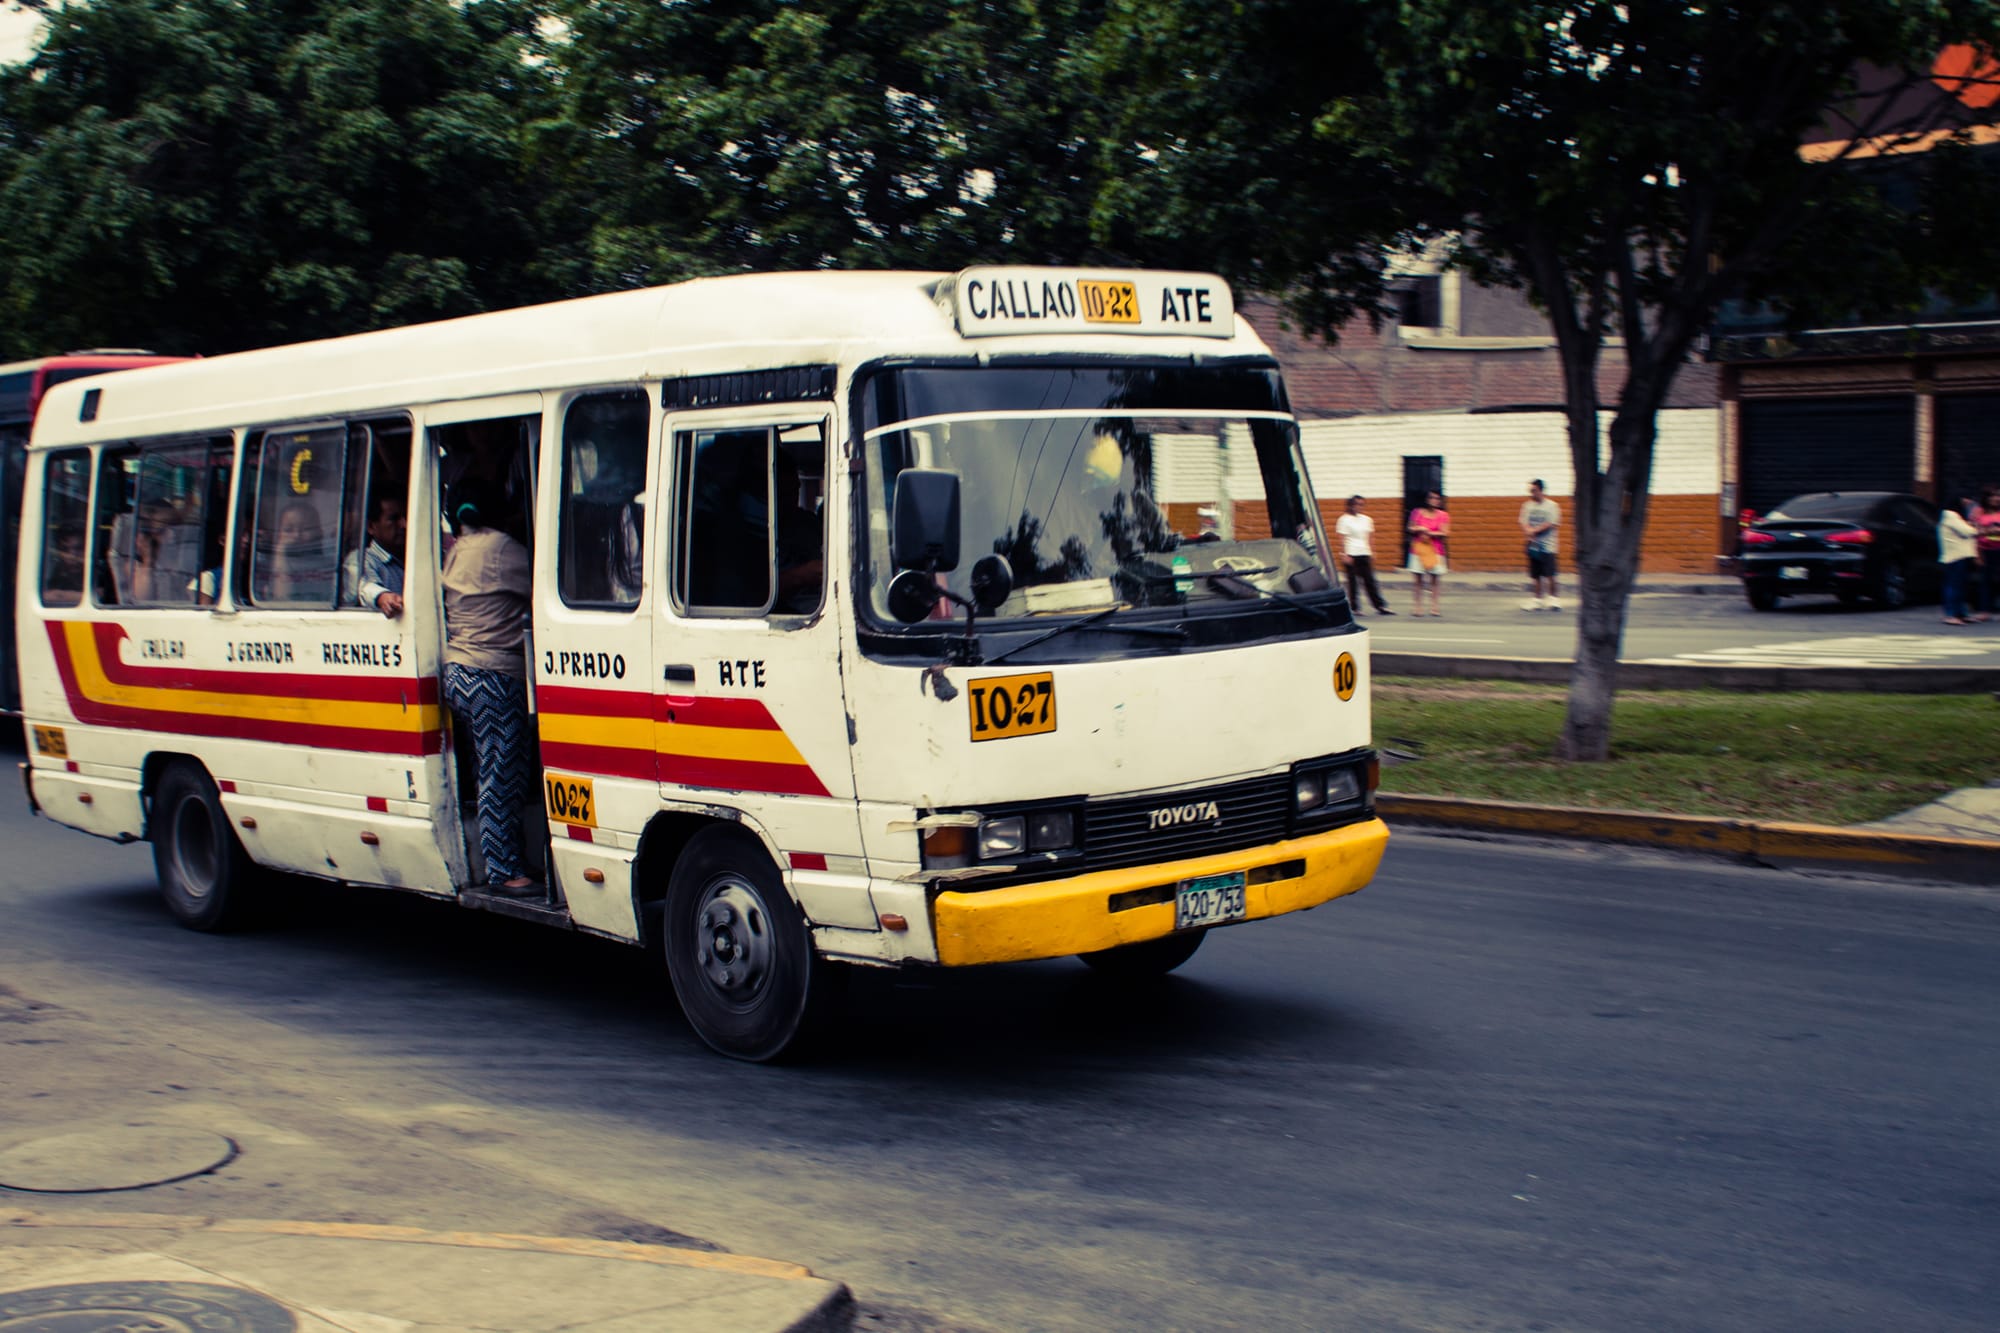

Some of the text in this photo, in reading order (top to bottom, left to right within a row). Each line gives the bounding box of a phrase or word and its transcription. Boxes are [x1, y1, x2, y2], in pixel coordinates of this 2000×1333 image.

[967, 280, 1076, 320] CALLAO
[1161, 287, 1212, 322] ATE
[291, 449, 312, 494] C
[321, 642, 402, 667] ARENALES
[719, 660, 767, 688] ATE
[1335, 661, 1354, 692] 10
[1147, 801, 1220, 830] TOYOTA
[1180, 885, 1244, 921] A20-753
